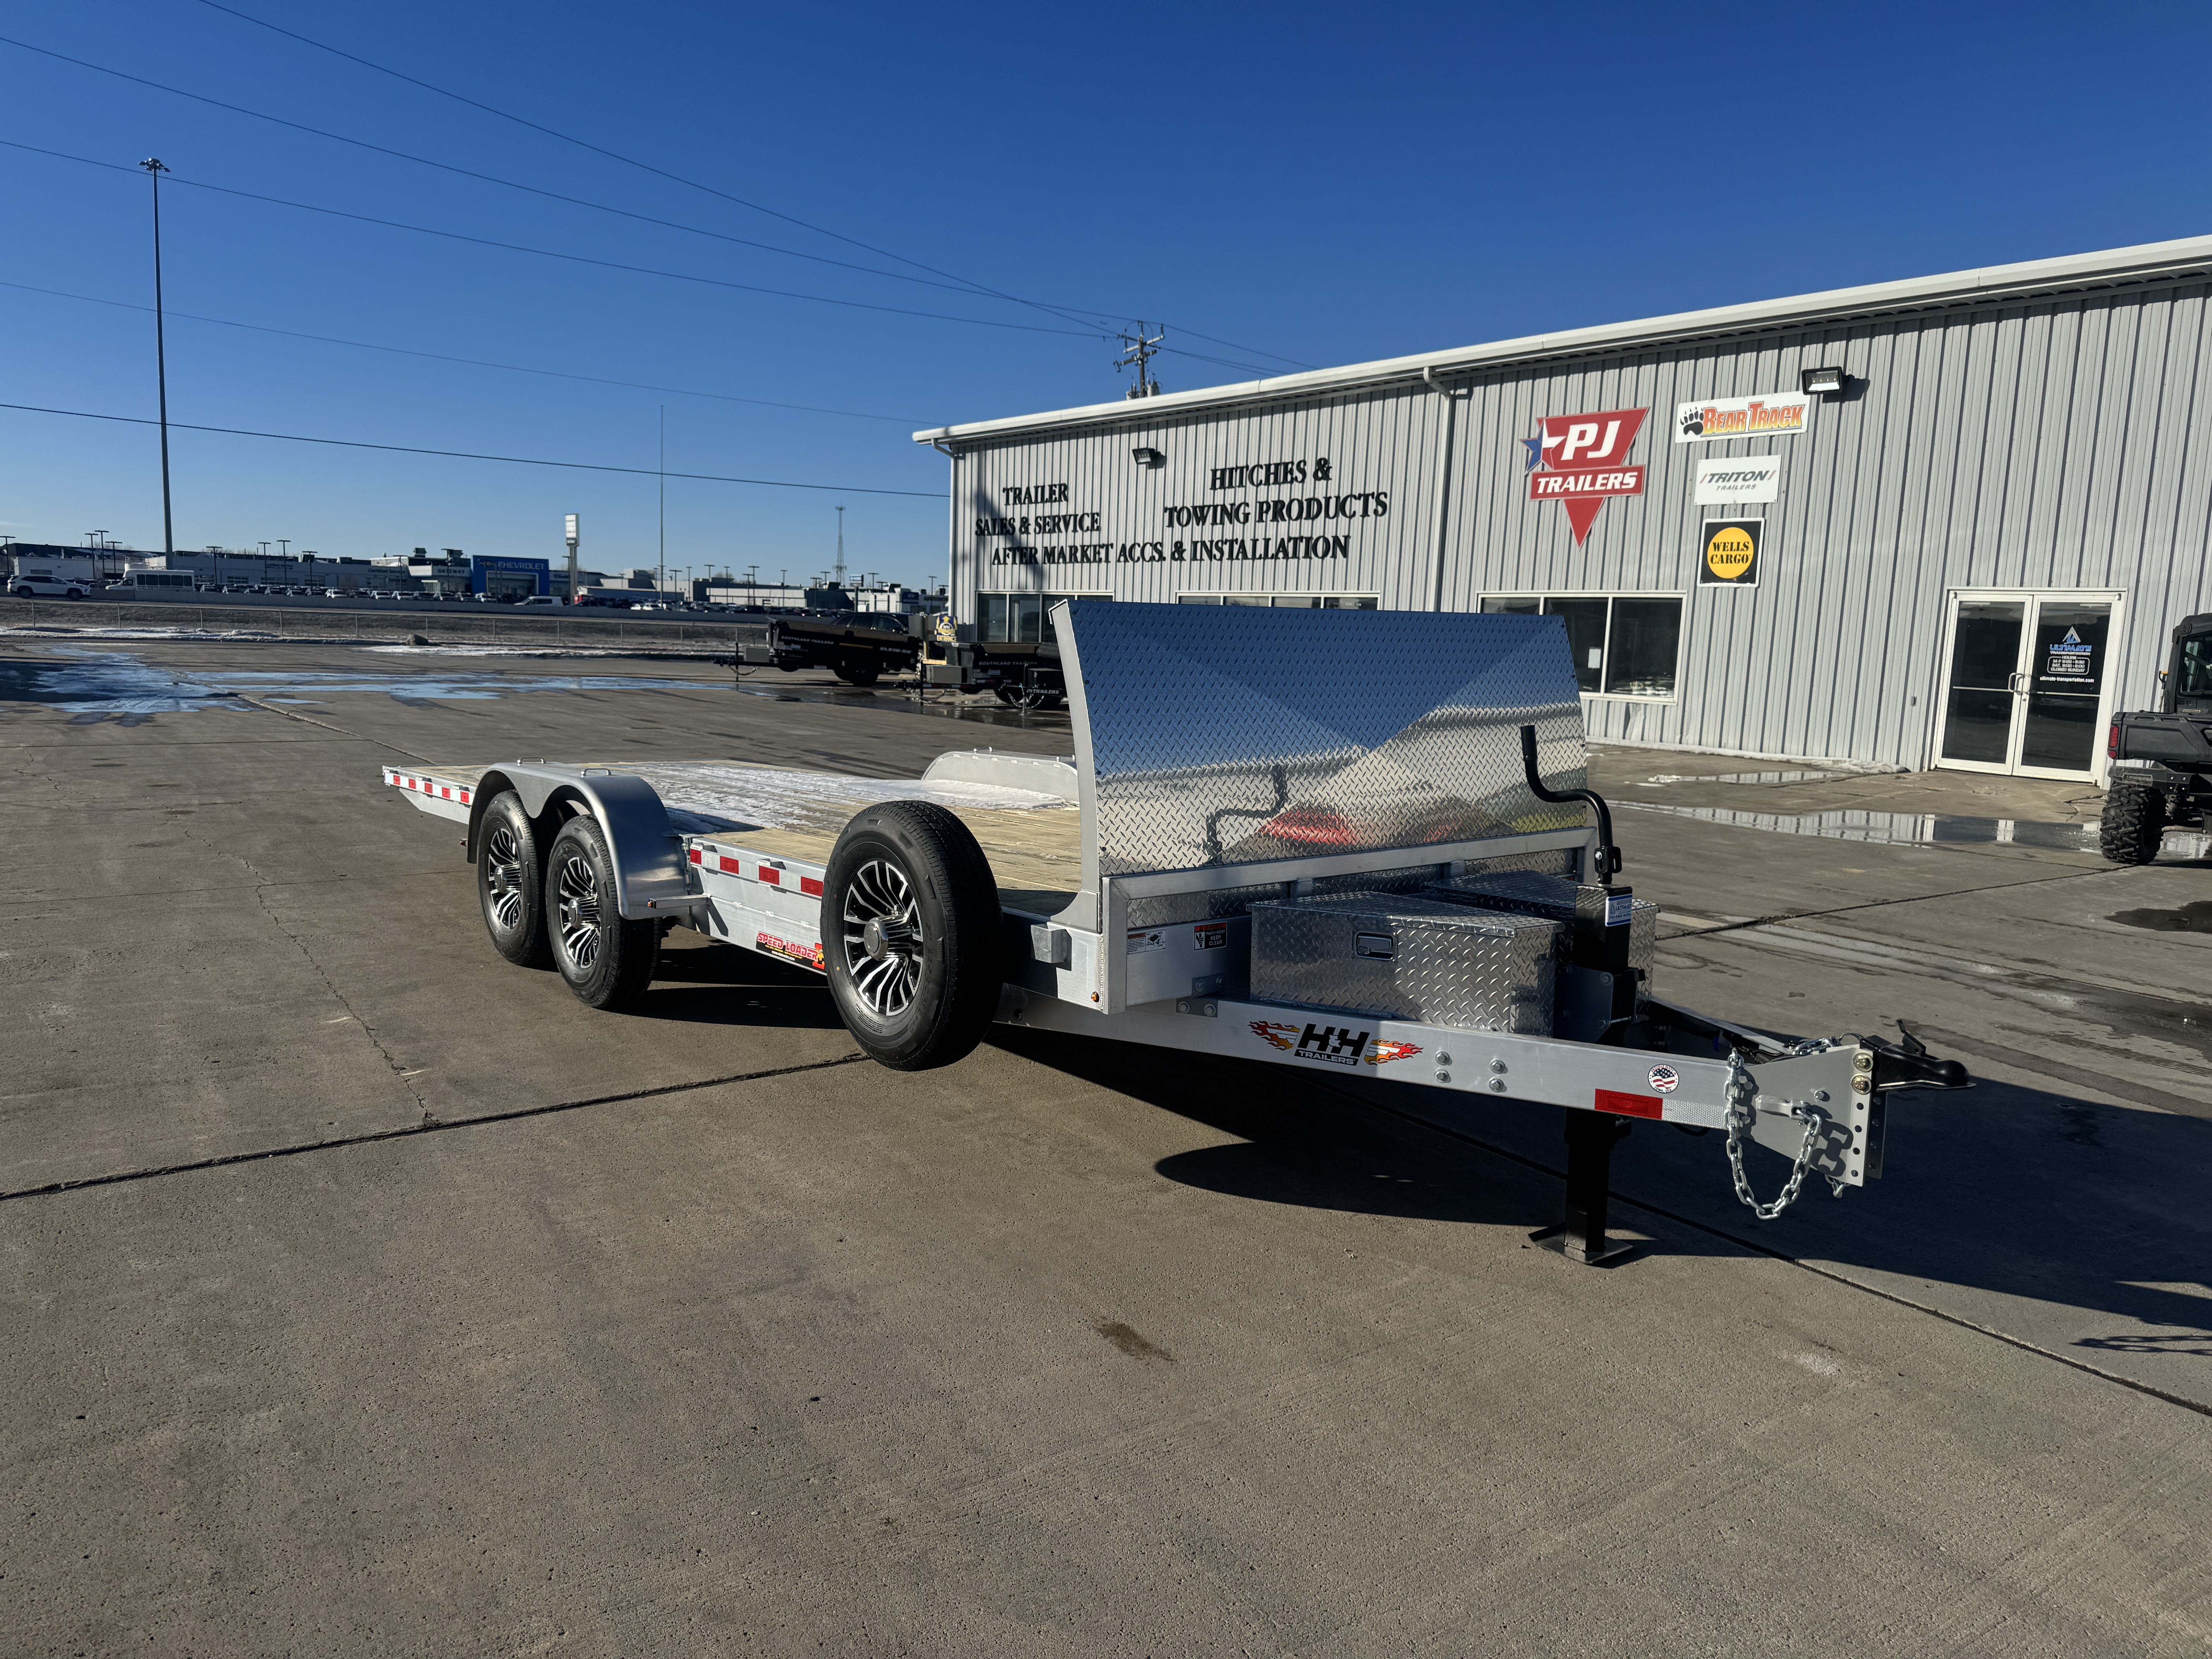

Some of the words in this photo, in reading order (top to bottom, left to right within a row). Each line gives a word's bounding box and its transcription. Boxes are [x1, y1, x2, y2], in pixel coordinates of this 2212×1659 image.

[1702, 407, 1747, 435] BEAR
[1748, 401, 1806, 431] TRACK
[1561, 420, 1621, 460] PJ
[1209, 460, 1307, 491] HITCHES
[1313, 458, 1333, 481] &
[1537, 472, 1638, 494] TRAILERS
[1708, 470, 1769, 483] TRITON
[1003, 483, 1068, 505] TRAILER
[1164, 502, 1250, 528] TOWING
[1257, 492, 1388, 523] PRODUCTS
[975, 517, 1015, 536] SALES
[1019, 516, 1031, 534] &
[1034, 512, 1101, 534] SERVICE
[992, 547, 1039, 565] AFTER
[1043, 543, 1113, 564] MARKET
[1117, 542, 1166, 563] ACCS.
[1171, 541, 1186, 562] &
[1191, 535, 1350, 562] INSTALLATION
[1713, 541, 1749, 552] WELLS
[498, 562, 544, 570] CHEVROLET
[1711, 554, 1749, 564] CARGO
[757, 932, 784, 949] SPEED
[785, 940, 819, 962] LOADER
[1297, 1023, 1370, 1058] H&H
[1299, 1051, 1355, 1065] TRAILERS
